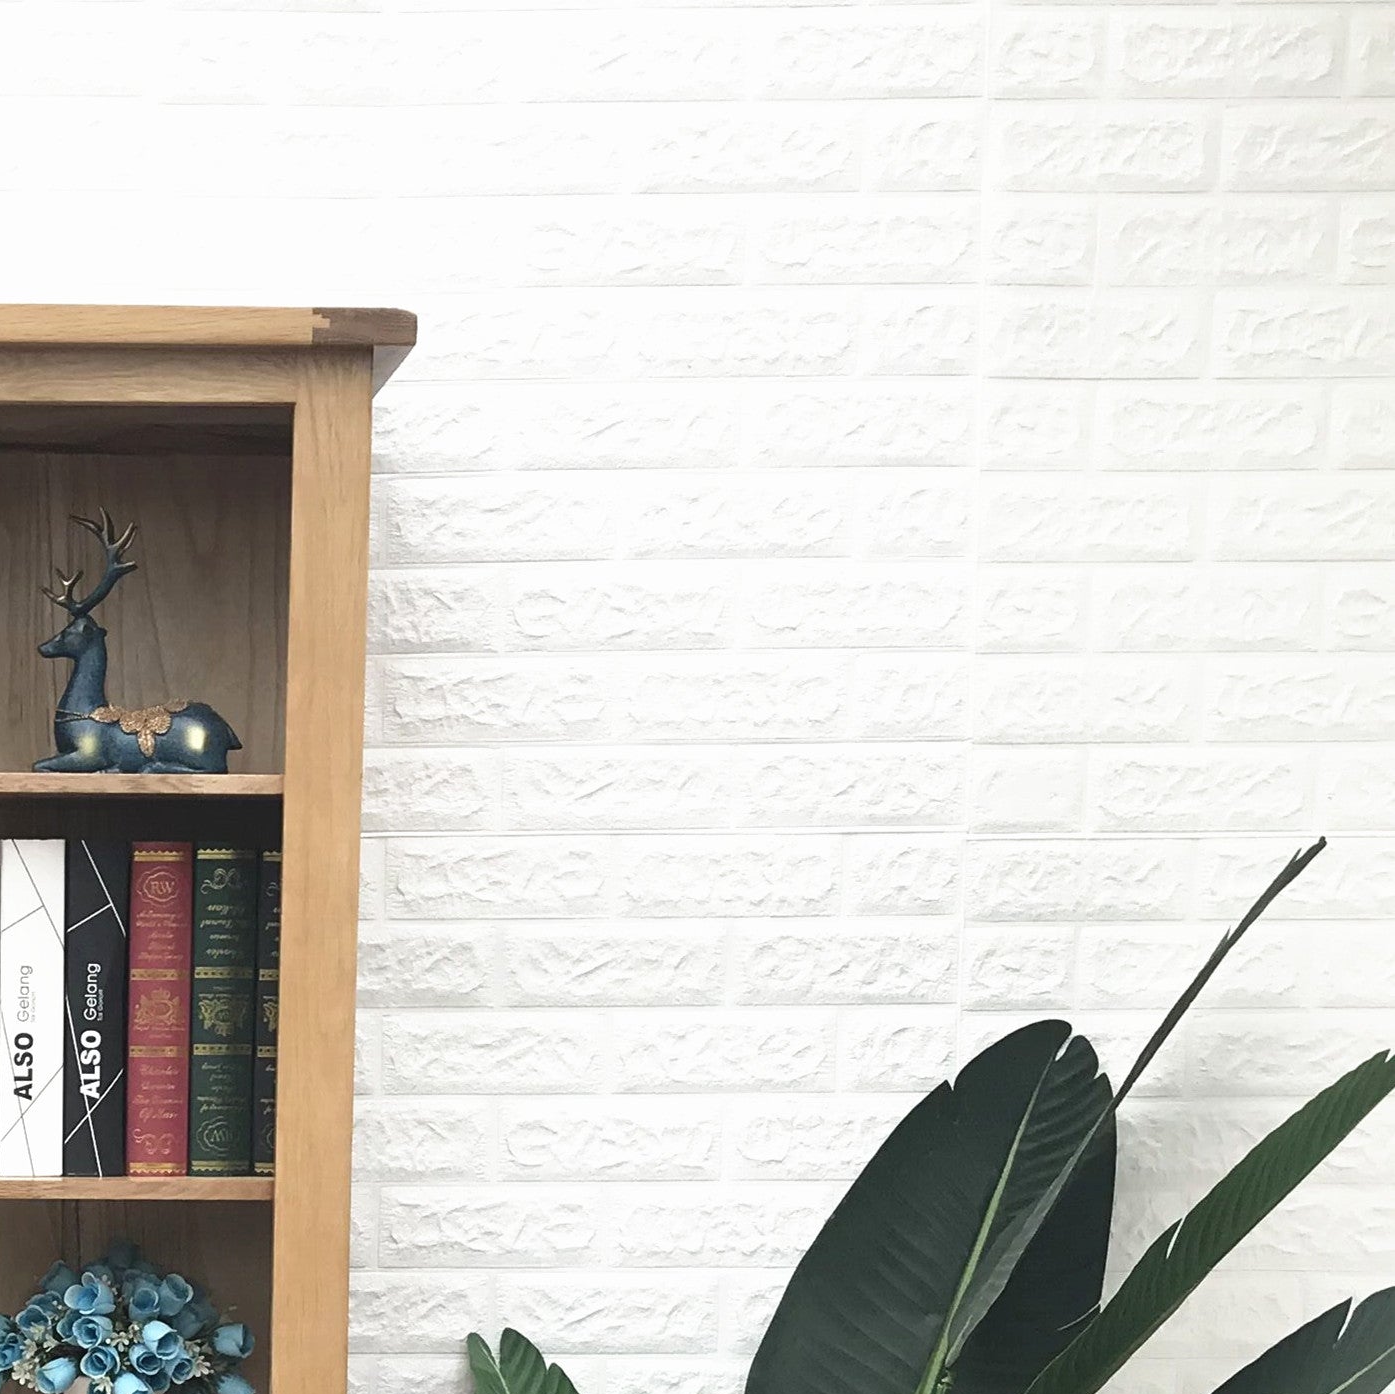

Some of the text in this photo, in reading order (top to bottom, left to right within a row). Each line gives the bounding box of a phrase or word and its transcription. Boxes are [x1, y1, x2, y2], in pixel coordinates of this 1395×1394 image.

[13, 964, 34, 1101] ALSO Gelang
[79, 962, 103, 1099] ALSO Gelang
